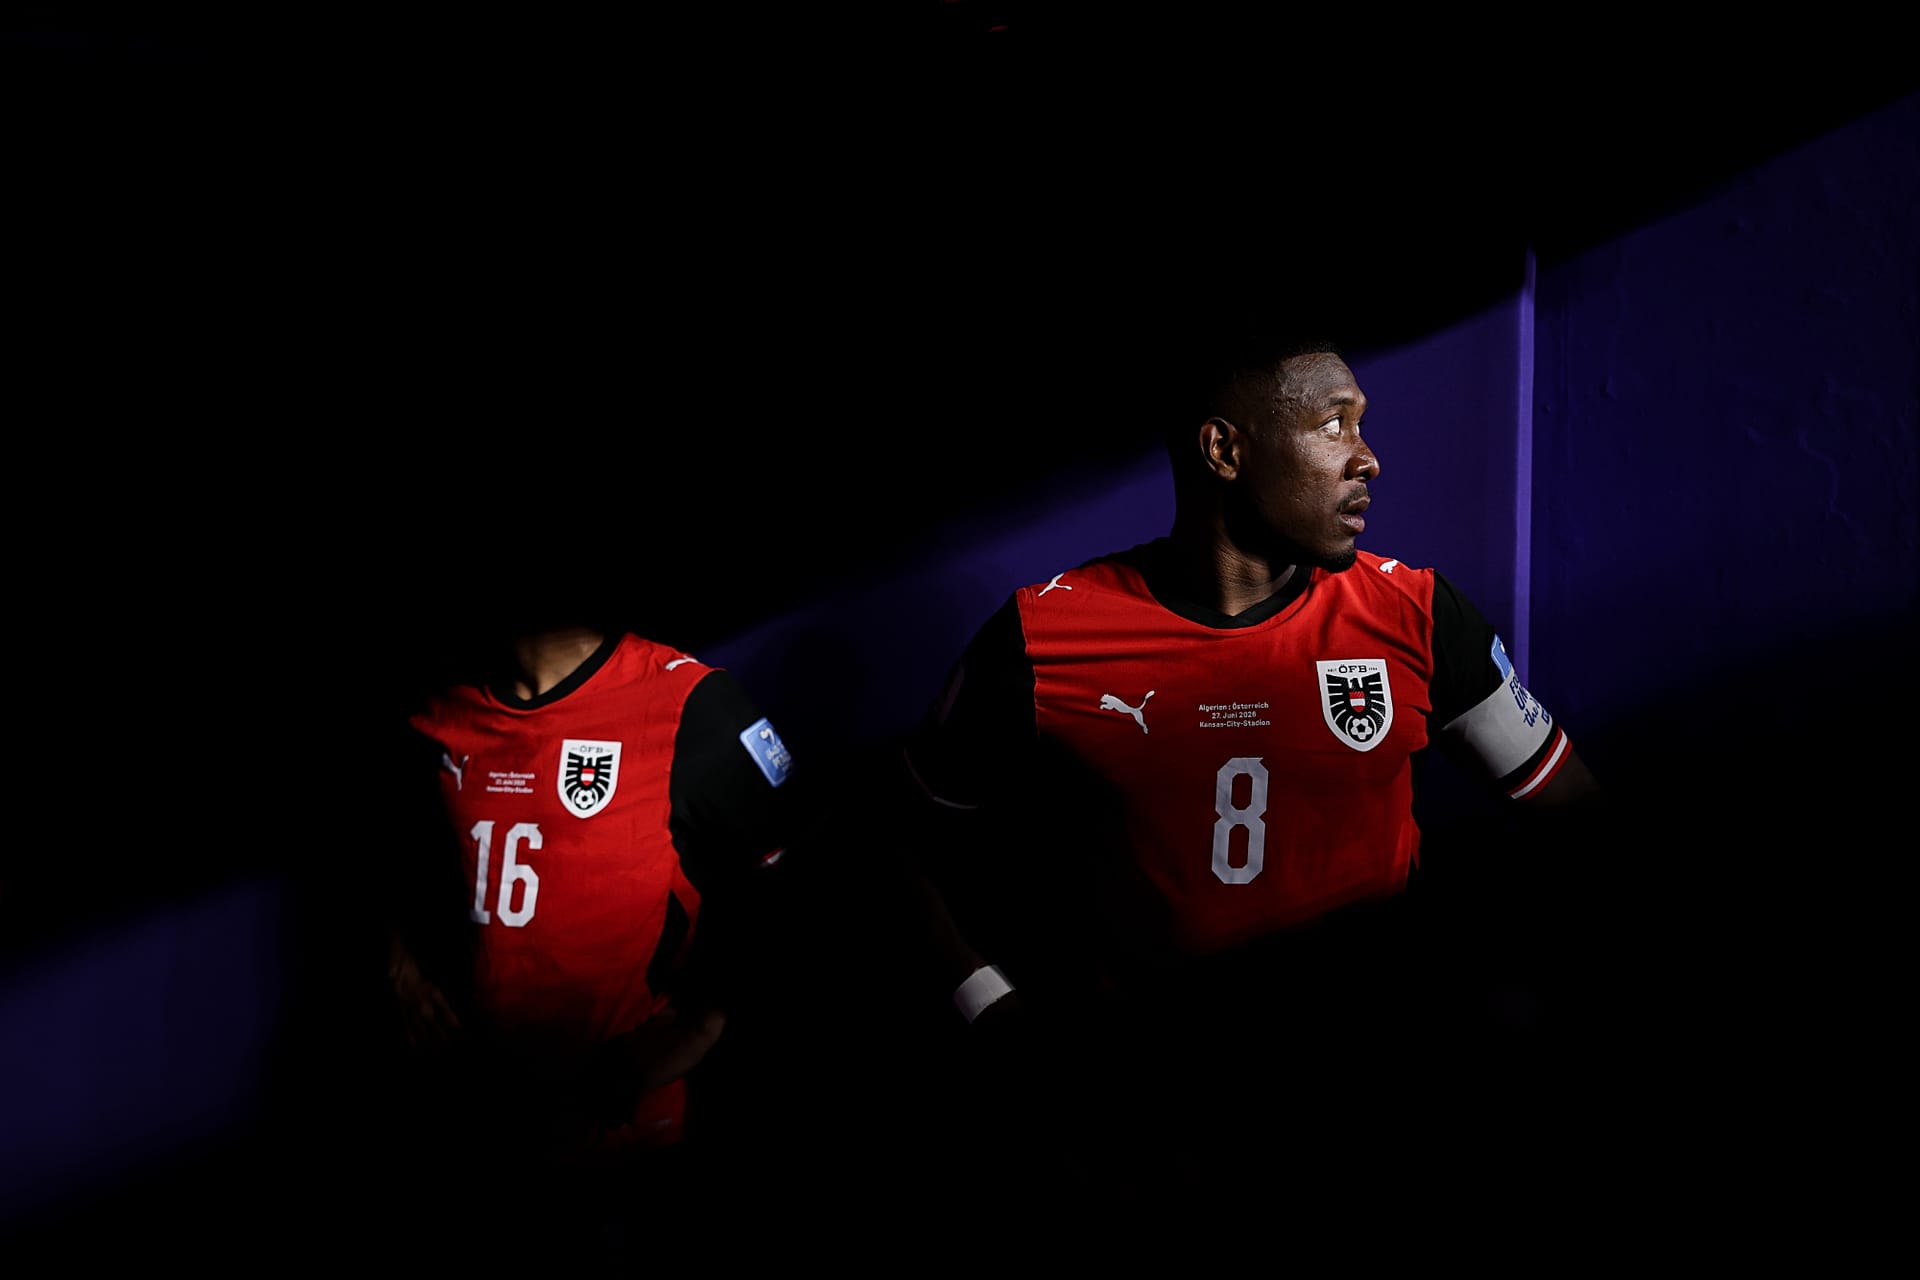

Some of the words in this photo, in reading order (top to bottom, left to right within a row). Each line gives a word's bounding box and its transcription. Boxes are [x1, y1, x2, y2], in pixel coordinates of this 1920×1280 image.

[1338, 664, 1367, 674] ÖFB
[1199, 704, 1227, 712] Algerien
[1232, 702, 1269, 710] Österreich
[1200, 720, 1270, 728] Kansas-City-Stadion
[1211, 757, 1269, 884] 8
[468, 819, 543, 928] 16
